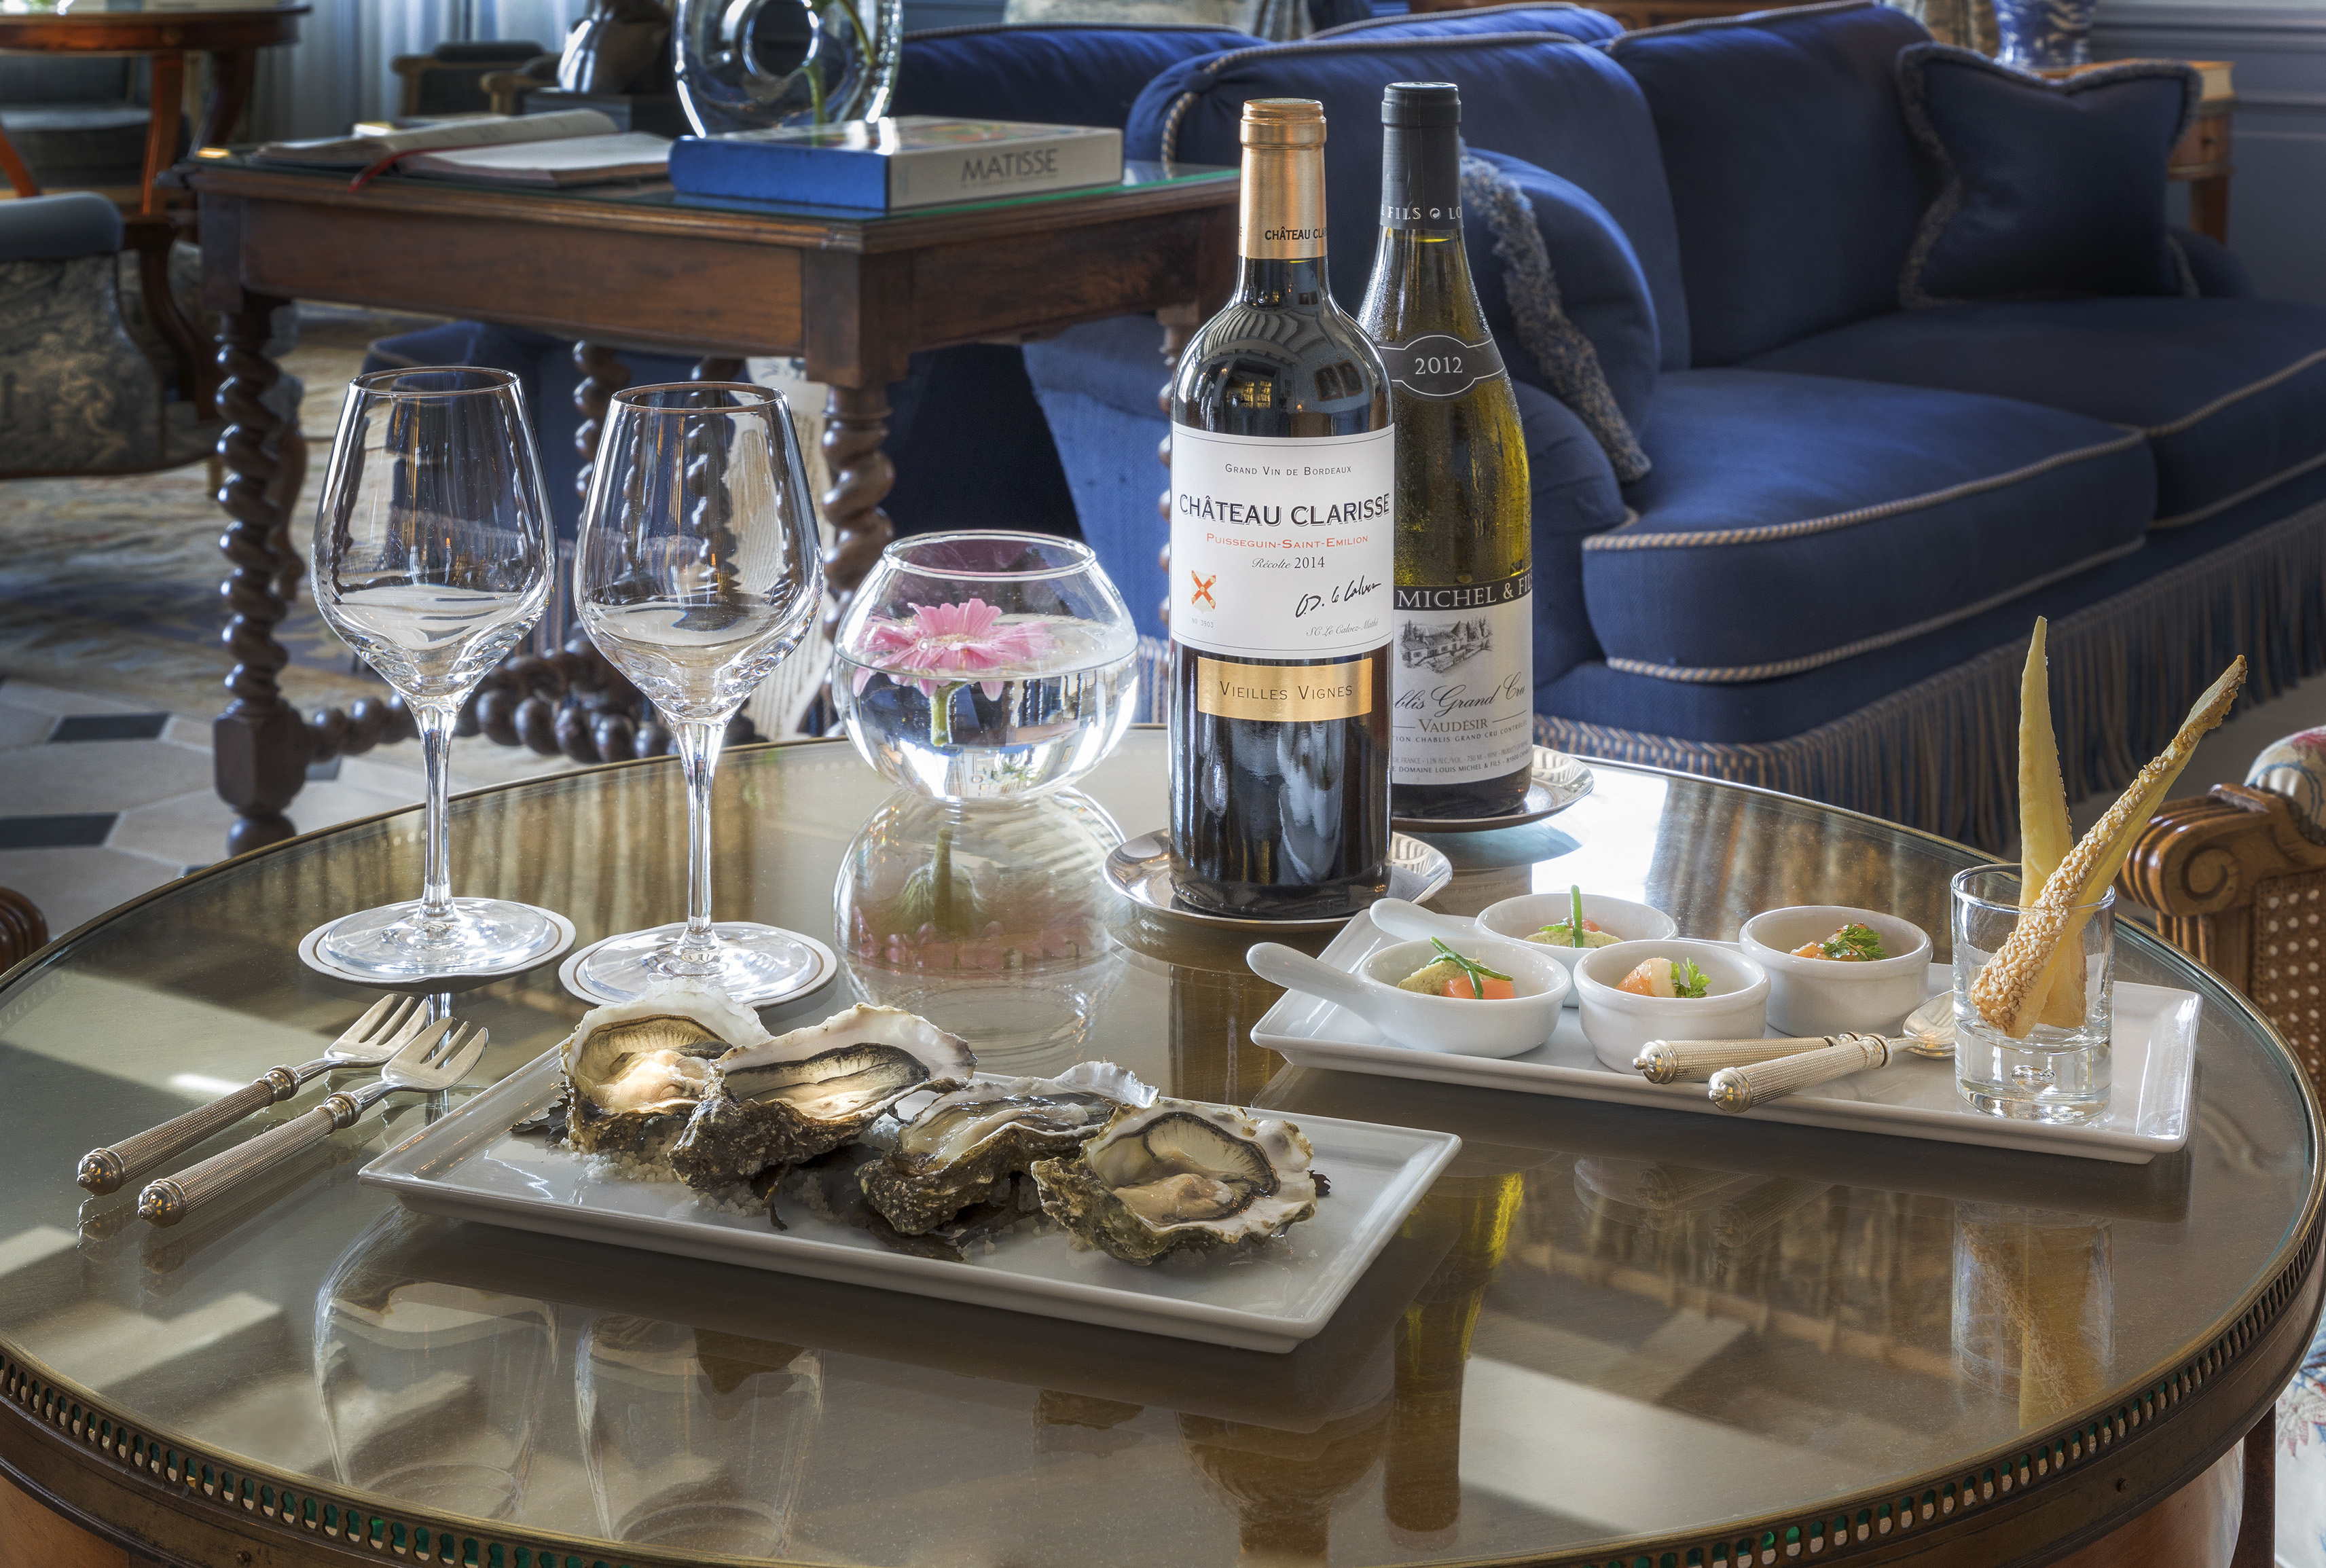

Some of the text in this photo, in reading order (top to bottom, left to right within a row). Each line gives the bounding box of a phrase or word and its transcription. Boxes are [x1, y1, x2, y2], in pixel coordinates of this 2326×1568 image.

[960, 147, 1059, 182] MATISSE
[1387, 206, 1421, 220] FILS
[1265, 226, 1311, 240] CHÂTEAU
[1415, 357, 1463, 375] 2012
[1180, 492, 1390, 527] CHÂTEAU CLARISSE
[1252, 557, 1325, 569] Récolte 2014
[1397, 586, 1497, 608] MICHEL
[1503, 582, 1514, 600] &
[1200, 619, 1214, 628] 3903
[1220, 680, 1352, 700] VIEILLES VIGNES
[1431, 684, 1501, 717] Grand
[1503, 671, 1525, 700] Cru
[1455, 733, 1481, 742] GRAND
[1485, 730, 1497, 738] CRU
[1458, 763, 1482, 771] MICHEL
